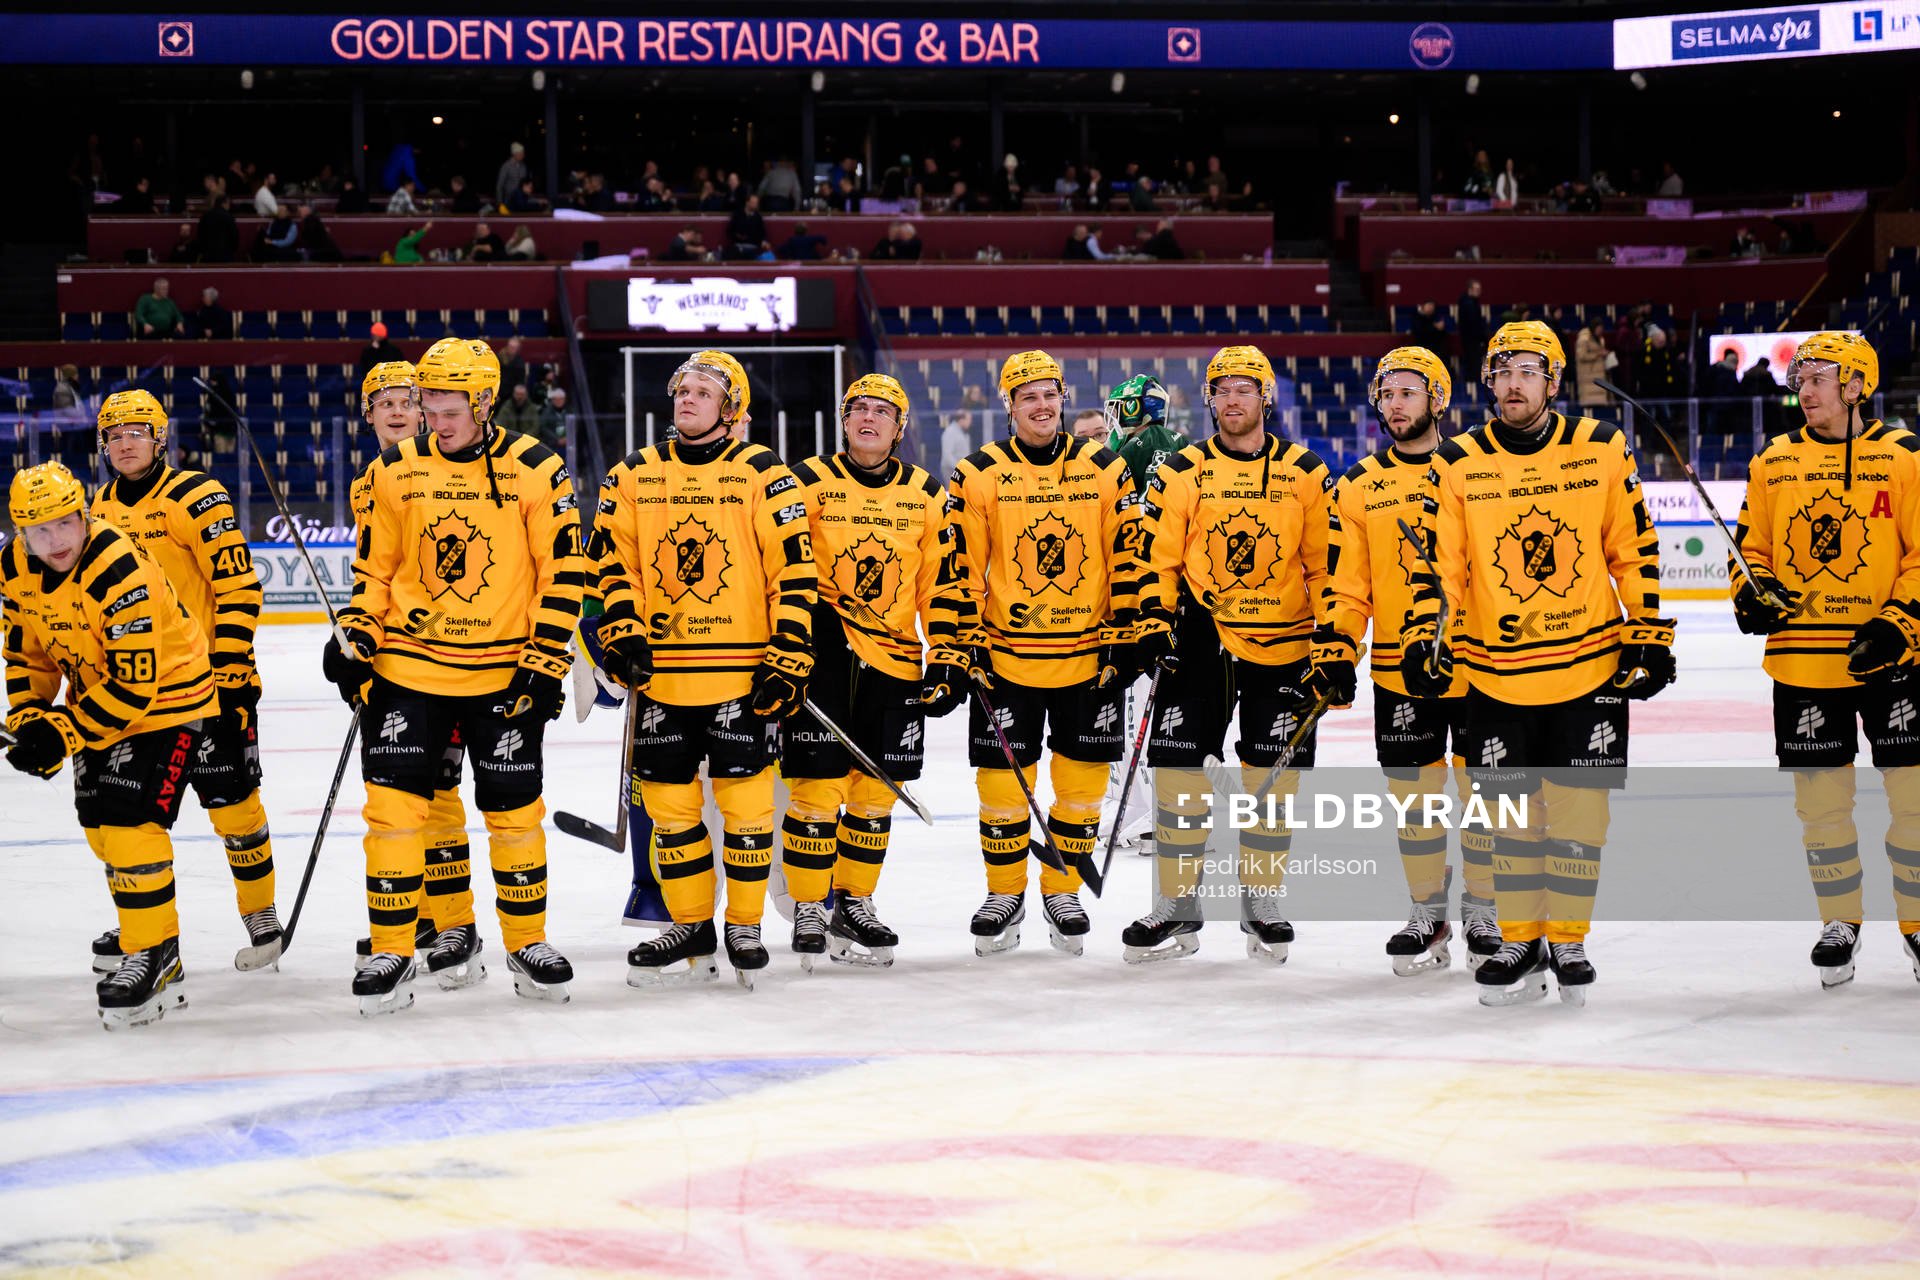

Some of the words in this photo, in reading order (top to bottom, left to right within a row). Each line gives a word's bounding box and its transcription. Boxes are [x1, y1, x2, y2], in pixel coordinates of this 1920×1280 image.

[1679, 22, 1768, 49] SELMA
[1769, 16, 1813, 51] spa
[331, 18, 513, 61] GOLDEN
[525, 19, 624, 62] STAR
[638, 20, 901, 63] RESTAURANG
[915, 23, 947, 63] &
[960, 22, 1040, 64] BAR
[676, 292, 749, 311] WERMLANDS
[1560, 457, 1598, 470] engcon
[1765, 455, 1801, 465] BROKK
[1858, 453, 1894, 463] engcon
[1465, 472, 1502, 480] BROKK
[1806, 472, 1847, 482] BOLIDE
[769, 476, 798, 494] HOLME
[1362, 479, 1397, 493] TEXOR
[1511, 483, 1558, 498] BOLIDEN
[1563, 478, 1599, 492] skebo
[435, 490, 480, 501] BOLIDEN
[672, 495, 714, 505] BOLIDEN
[825, 491, 847, 499] LEAB
[1223, 490, 1267, 499] BOLIDEN
[1465, 491, 1502, 502] ŠKODA
[895, 501, 925, 510] engco
[1364, 498, 1400, 512] ŠKODA
[1648, 496, 1699, 509] ENSKA
[1869, 490, 1893, 519] A
[853, 515, 893, 527] BOLIDEN
[1121, 521, 1147, 557] 24
[216, 546, 248, 576] 40
[252, 555, 356, 587] OYAL
[1659, 561, 1728, 580] VermKo
[1824, 595, 1873, 605] Skellefteå
[1050, 604, 1092, 616] Skellefteå
[1239, 606, 1260, 615] Kraft
[1543, 604, 1588, 622] Skellefteå
[1824, 605, 1849, 615] Kraft
[445, 616, 492, 628] Skellefteå
[687, 615, 733, 625] Skellefteå
[1050, 616, 1071, 625] Kraft
[444, 627, 468, 637] Kraft
[687, 626, 712, 635] Kraft
[1544, 621, 1570, 633] Kraft
[1100, 630, 1135, 640] CC
[1631, 629, 1674, 643] CC
[934, 650, 970, 668] CC
[115, 652, 153, 682] 58
[1594, 695, 1623, 705] CCM
[792, 731, 840, 743] HOLME
[974, 737, 1026, 750] martions
[1783, 740, 1843, 752] martinsons
[369, 744, 425, 756] martinsons
[478, 759, 536, 773] martinsons
[1570, 755, 1625, 768] martinsons
[156, 731, 193, 814] REPAY
[435, 839, 458, 847] CCM
[787, 836, 834, 853] NORRAN
[846, 831, 889, 848] NORRA
[1062, 839, 1096, 851] NORR
[228, 850, 264, 865] ORRAN
[727, 851, 771, 863] NORRAN
[424, 863, 470, 879] NORRAN
[510, 861, 535, 870] CCM
[1552, 860, 1599, 876] NORRAN
[500, 884, 546, 900] NORRAN
